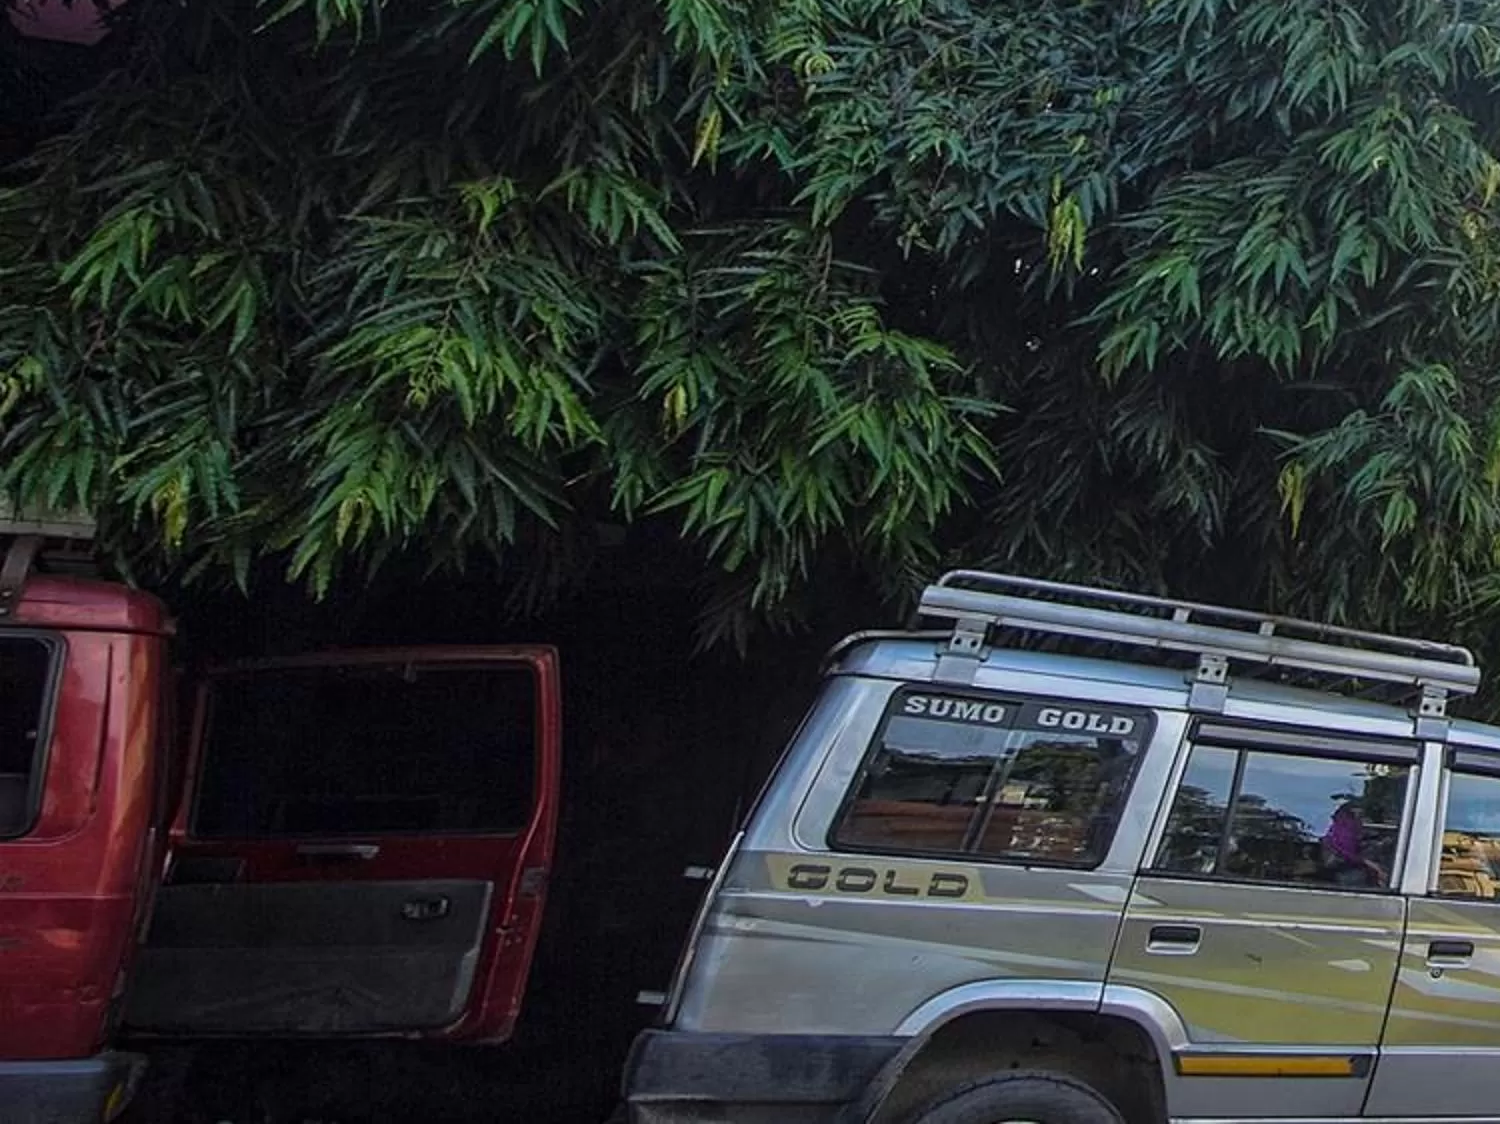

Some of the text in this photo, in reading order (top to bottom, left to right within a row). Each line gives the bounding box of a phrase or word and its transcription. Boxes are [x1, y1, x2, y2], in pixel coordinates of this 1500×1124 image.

[903, 694, 1135, 736] SUMO GOLD
[786, 863, 969, 898] GOLD
